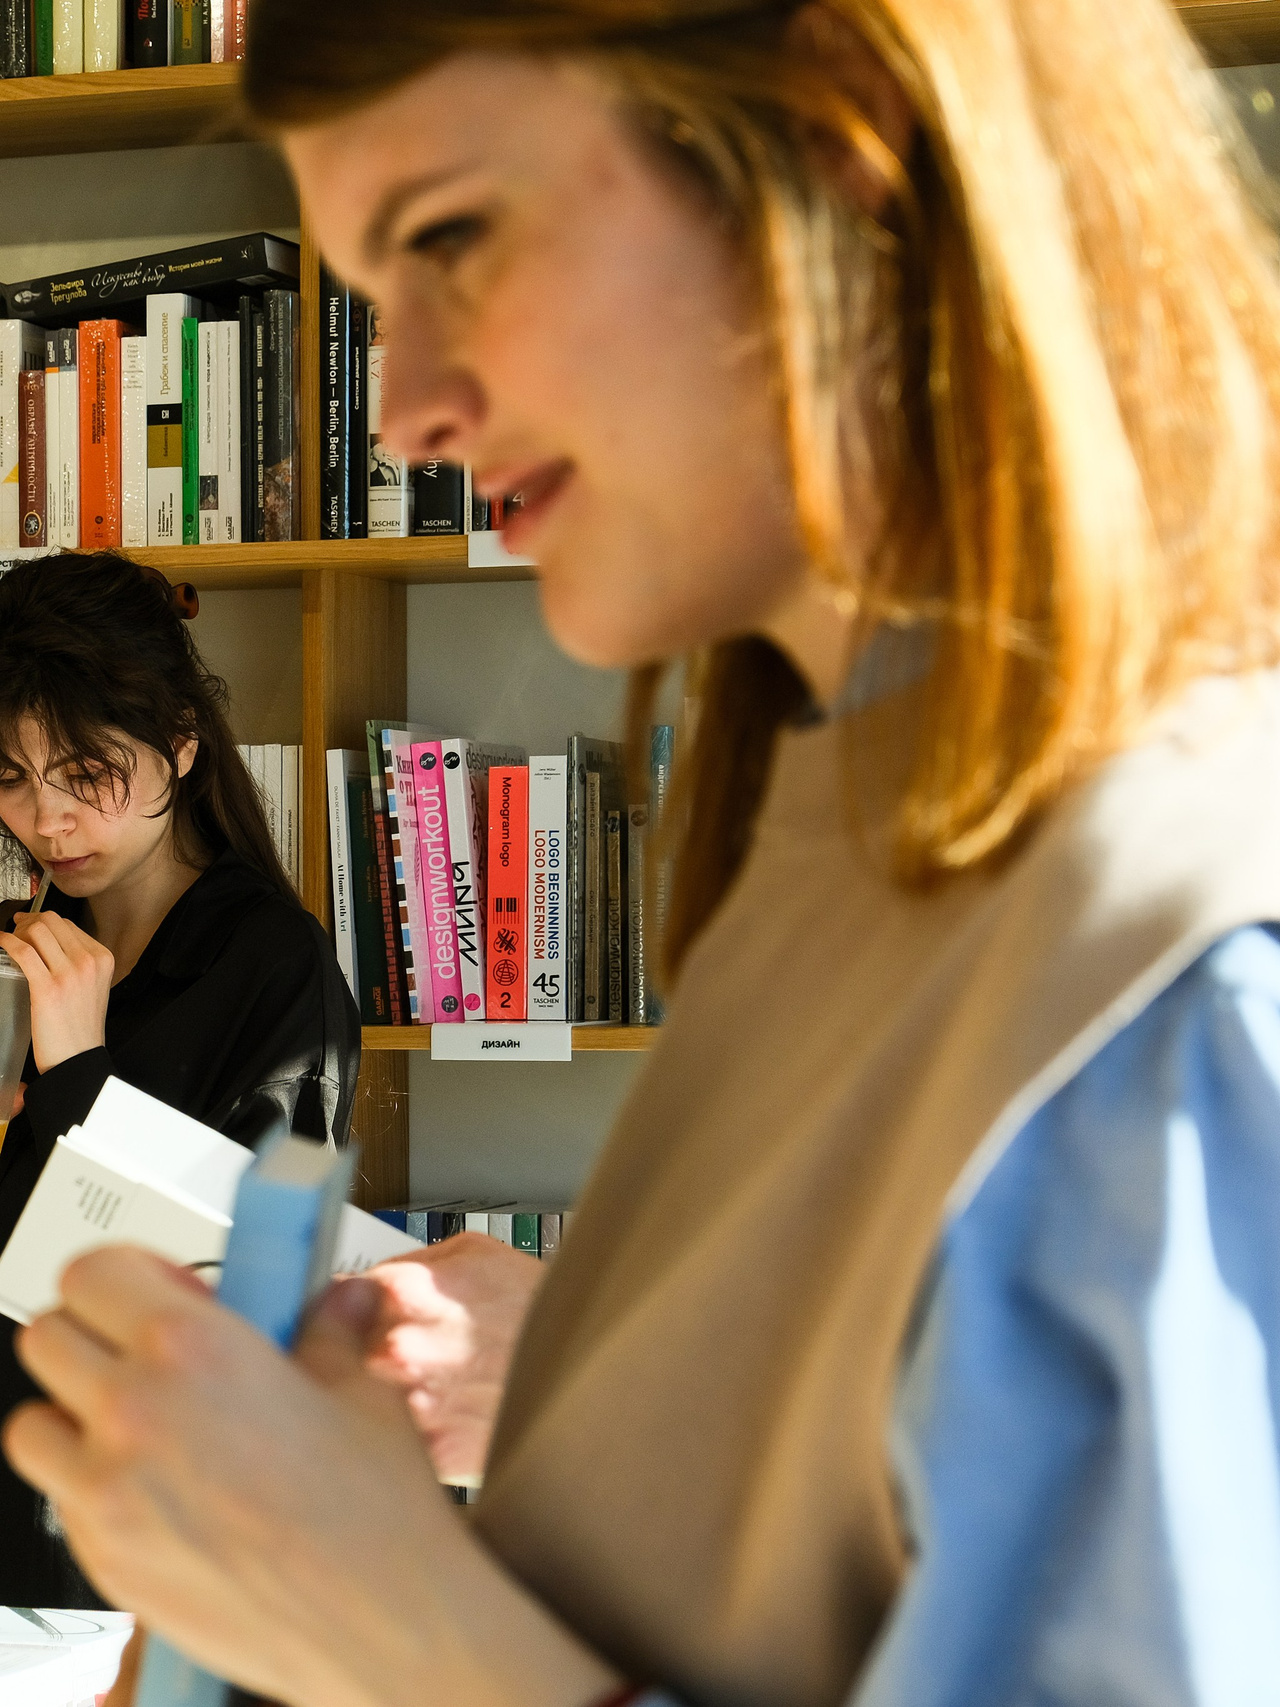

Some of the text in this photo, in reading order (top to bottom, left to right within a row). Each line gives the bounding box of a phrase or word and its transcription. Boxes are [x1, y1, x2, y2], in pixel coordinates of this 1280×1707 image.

[168, 255, 222, 274] История моей жизни
[50, 278, 84, 293] Зельфира
[50, 289, 88, 304] Трегулова
[326, 297, 339, 467] Helmut Newton Berlin, Berlin
[330, 496, 338, 532] TASCHEN
[501, 777, 512, 867] Monogram logo
[417, 784, 457, 979] designworkout
[534, 830, 545, 960] LOGO MODERNISM
[548, 830, 560, 960] LOGO BEGINNINGS
[533, 972, 560, 996] 45
[500, 992, 511, 1008] 2
[482, 1039, 520, 1048] ДИЗАЙН
